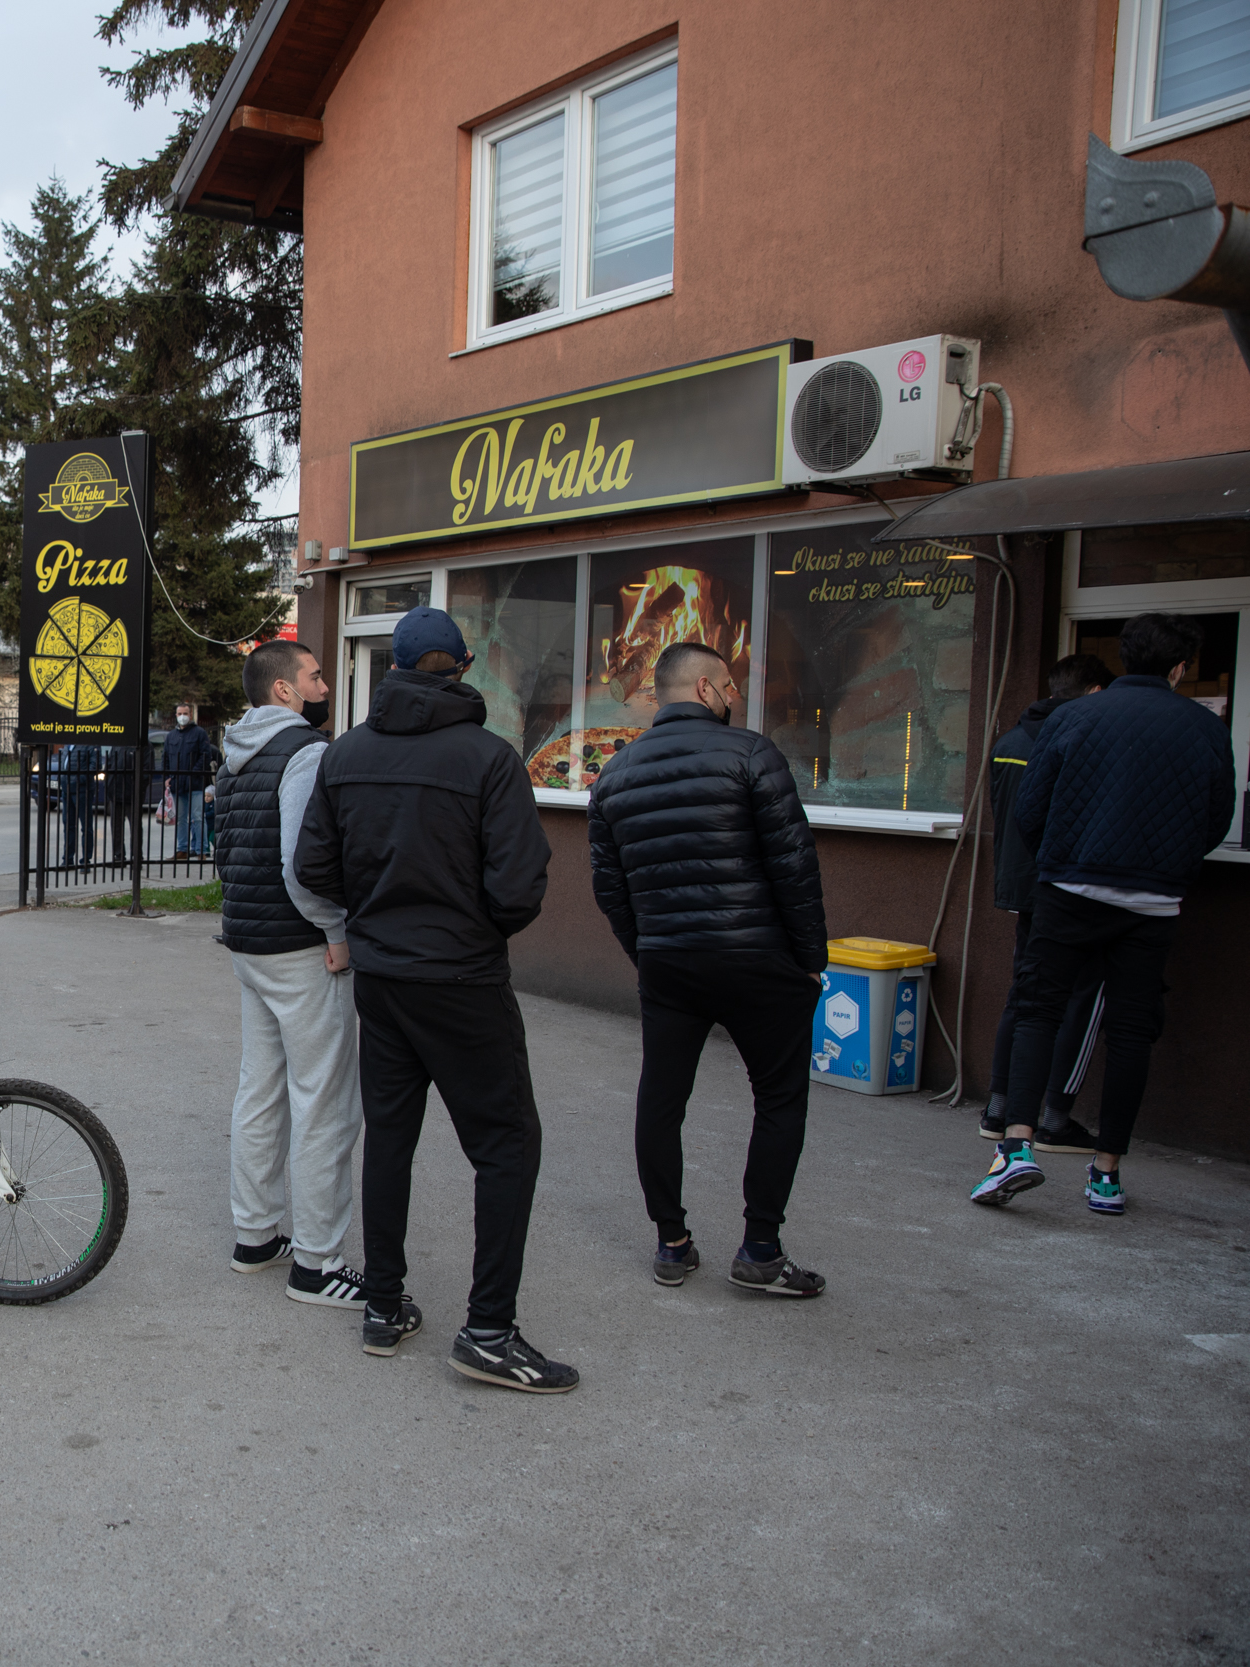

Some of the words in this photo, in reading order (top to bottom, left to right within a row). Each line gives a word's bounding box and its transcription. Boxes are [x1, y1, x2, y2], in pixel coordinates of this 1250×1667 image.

[899, 386, 921, 403] LG
[450, 416, 634, 525] Nafaka
[62, 483, 105, 505] Nafaka
[35, 540, 129, 593] Pizza
[791, 546, 842, 572] Okusi
[845, 552, 868, 567] se
[869, 550, 895, 567] ne
[808, 578, 858, 603] okusi
[859, 581, 882, 600] se
[884, 571, 974, 608] stvaraju.
[31, 721, 54, 731] vakat
[55, 722, 63, 734] je
[64, 724, 74, 732] za
[76, 725, 100, 734] pravu
[102, 723, 124, 733] Pizzu
[832, 1011, 851, 1020] PAPIR
